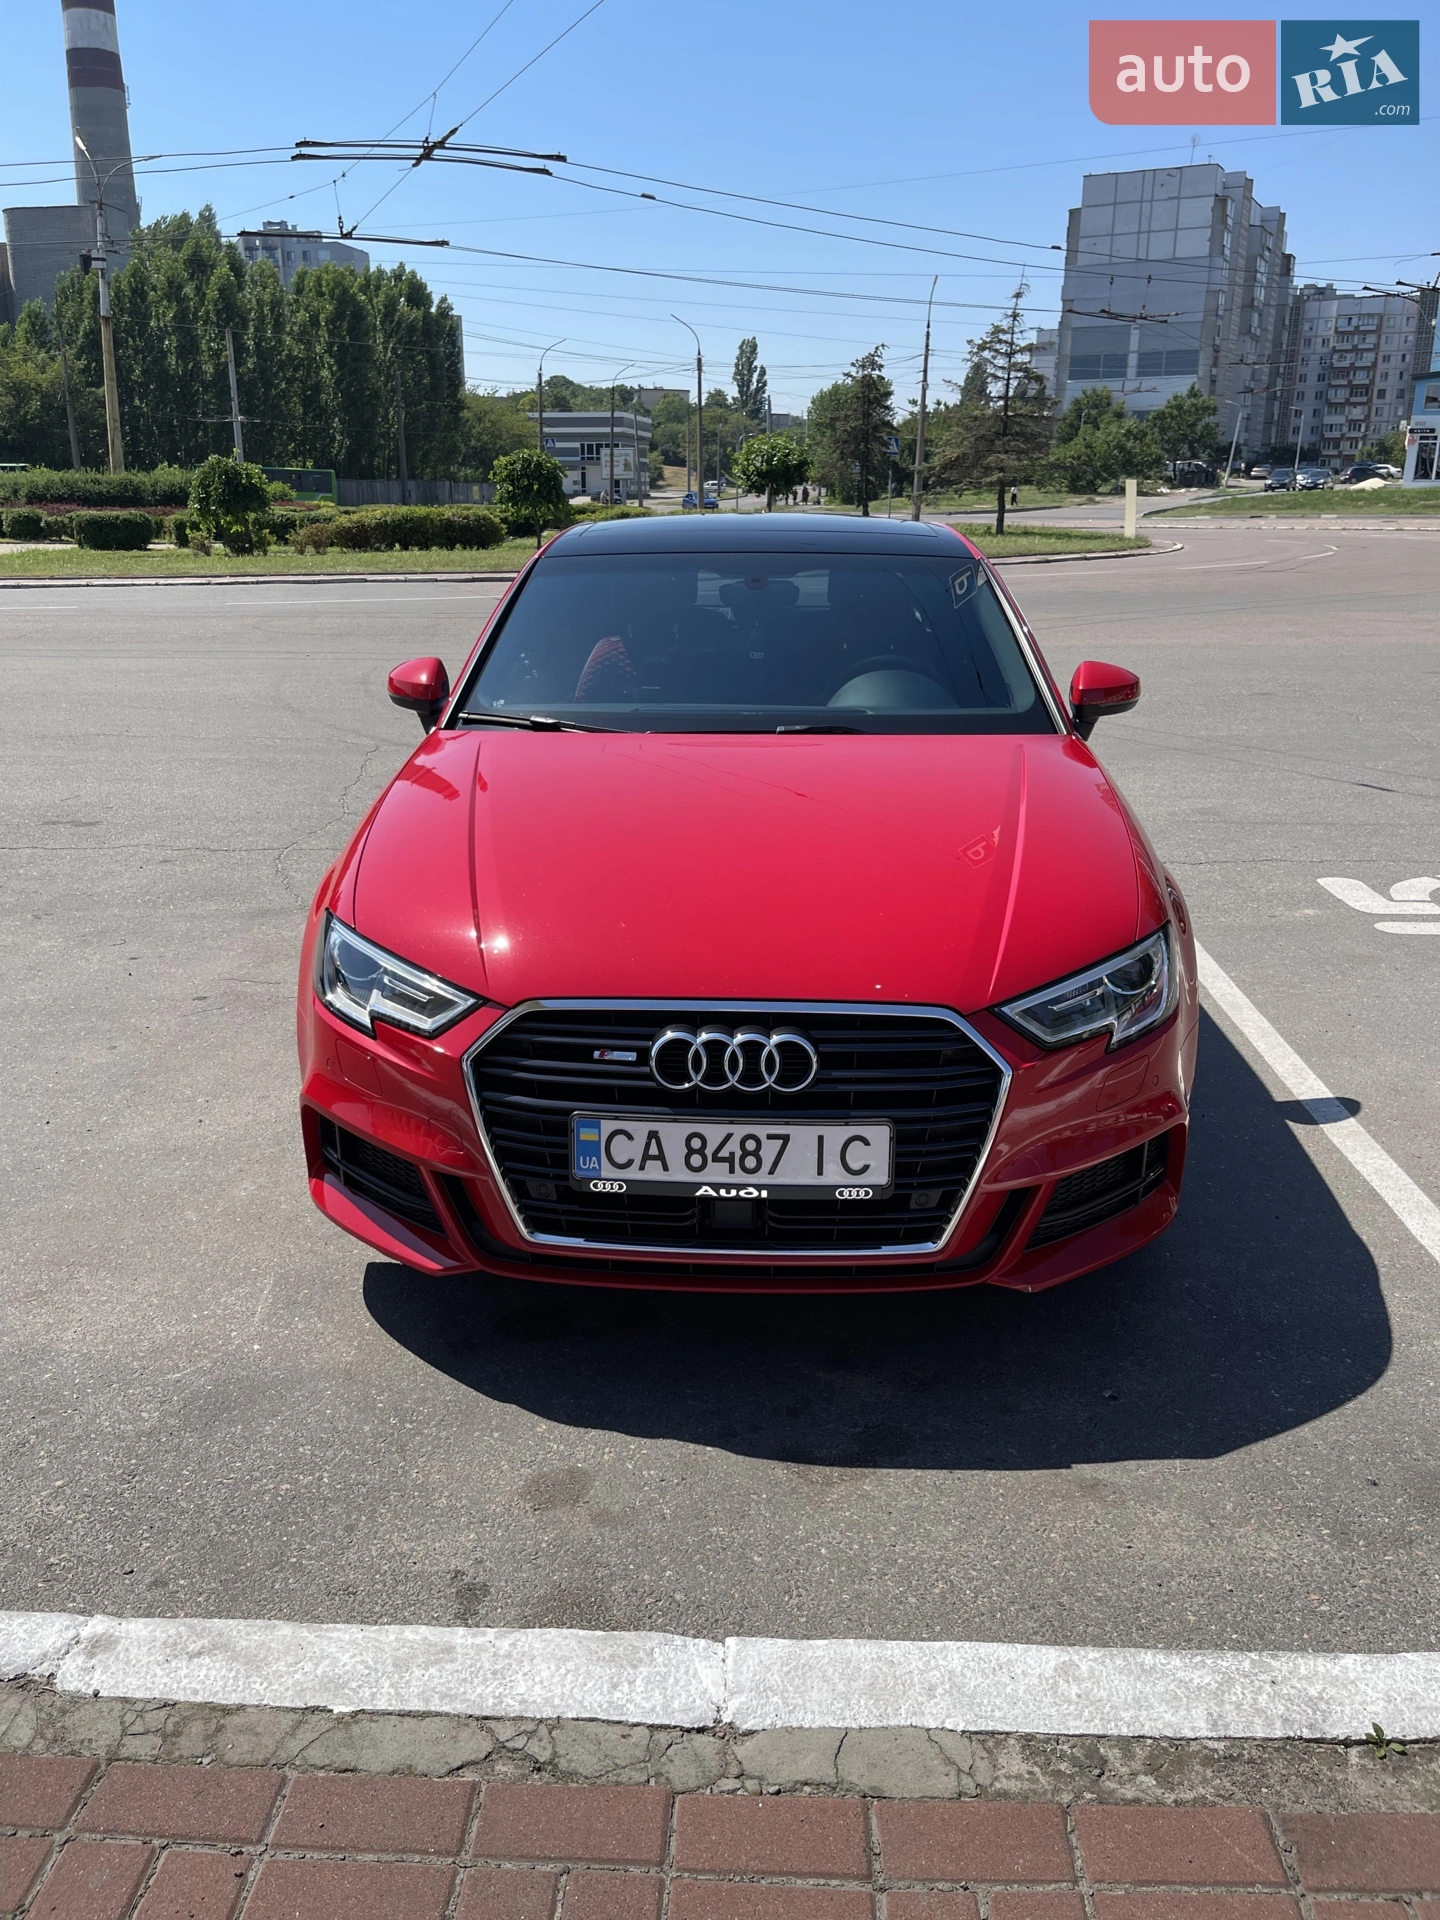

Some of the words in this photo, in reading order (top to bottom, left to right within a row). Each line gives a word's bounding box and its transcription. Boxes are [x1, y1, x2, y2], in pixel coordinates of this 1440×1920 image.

[604, 1129, 669, 1172] CA
[684, 1132, 791, 1175] 8487
[816, 1135, 871, 1176] IC
[579, 1156, 600, 1170] UA
[694, 1185, 768, 1198] Audi
